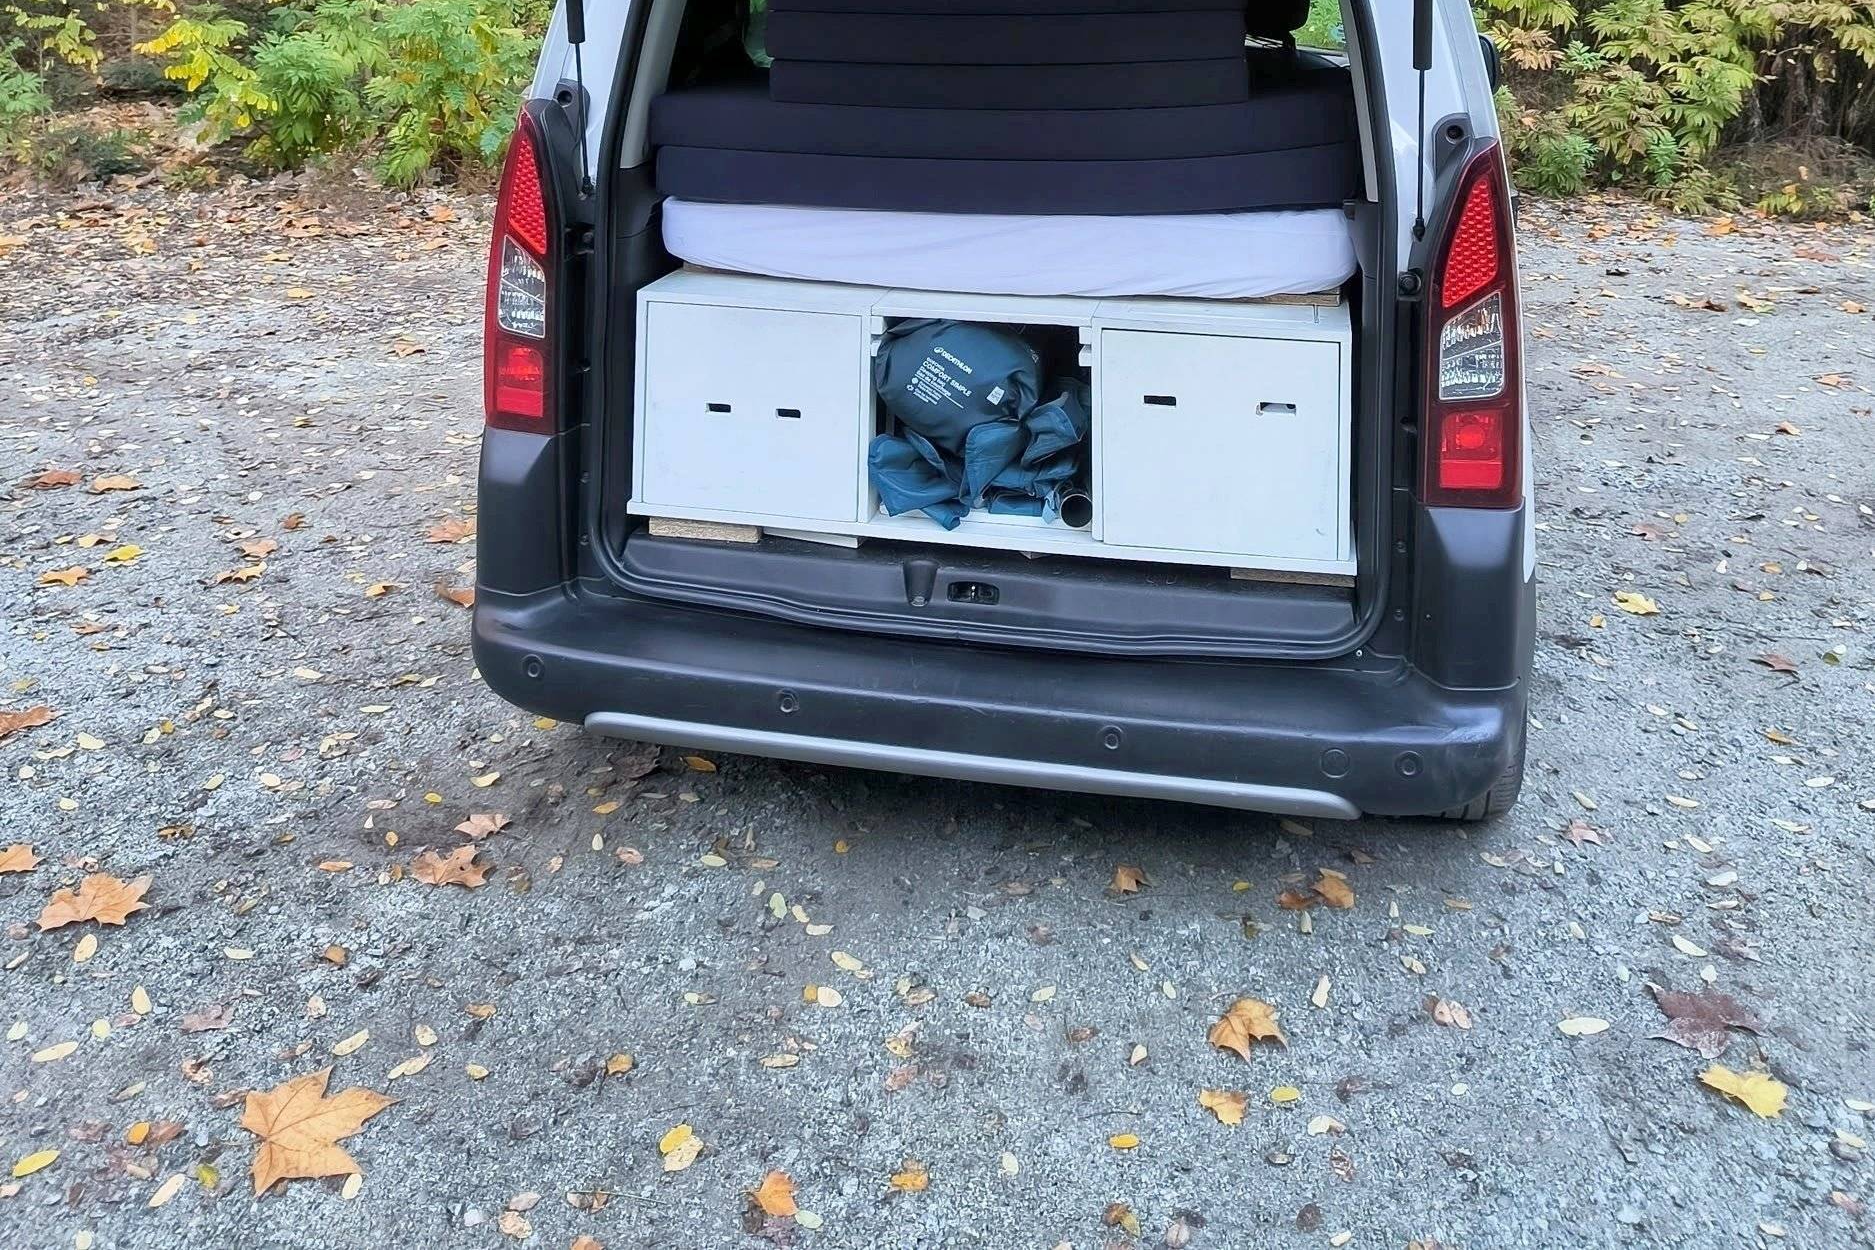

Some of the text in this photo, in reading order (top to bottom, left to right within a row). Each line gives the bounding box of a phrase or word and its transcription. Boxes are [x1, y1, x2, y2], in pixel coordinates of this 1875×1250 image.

[941, 350, 973, 374] DECATHLON
[922, 360, 952, 382] COMFORT
[950, 379, 972, 397] SIMPLE
